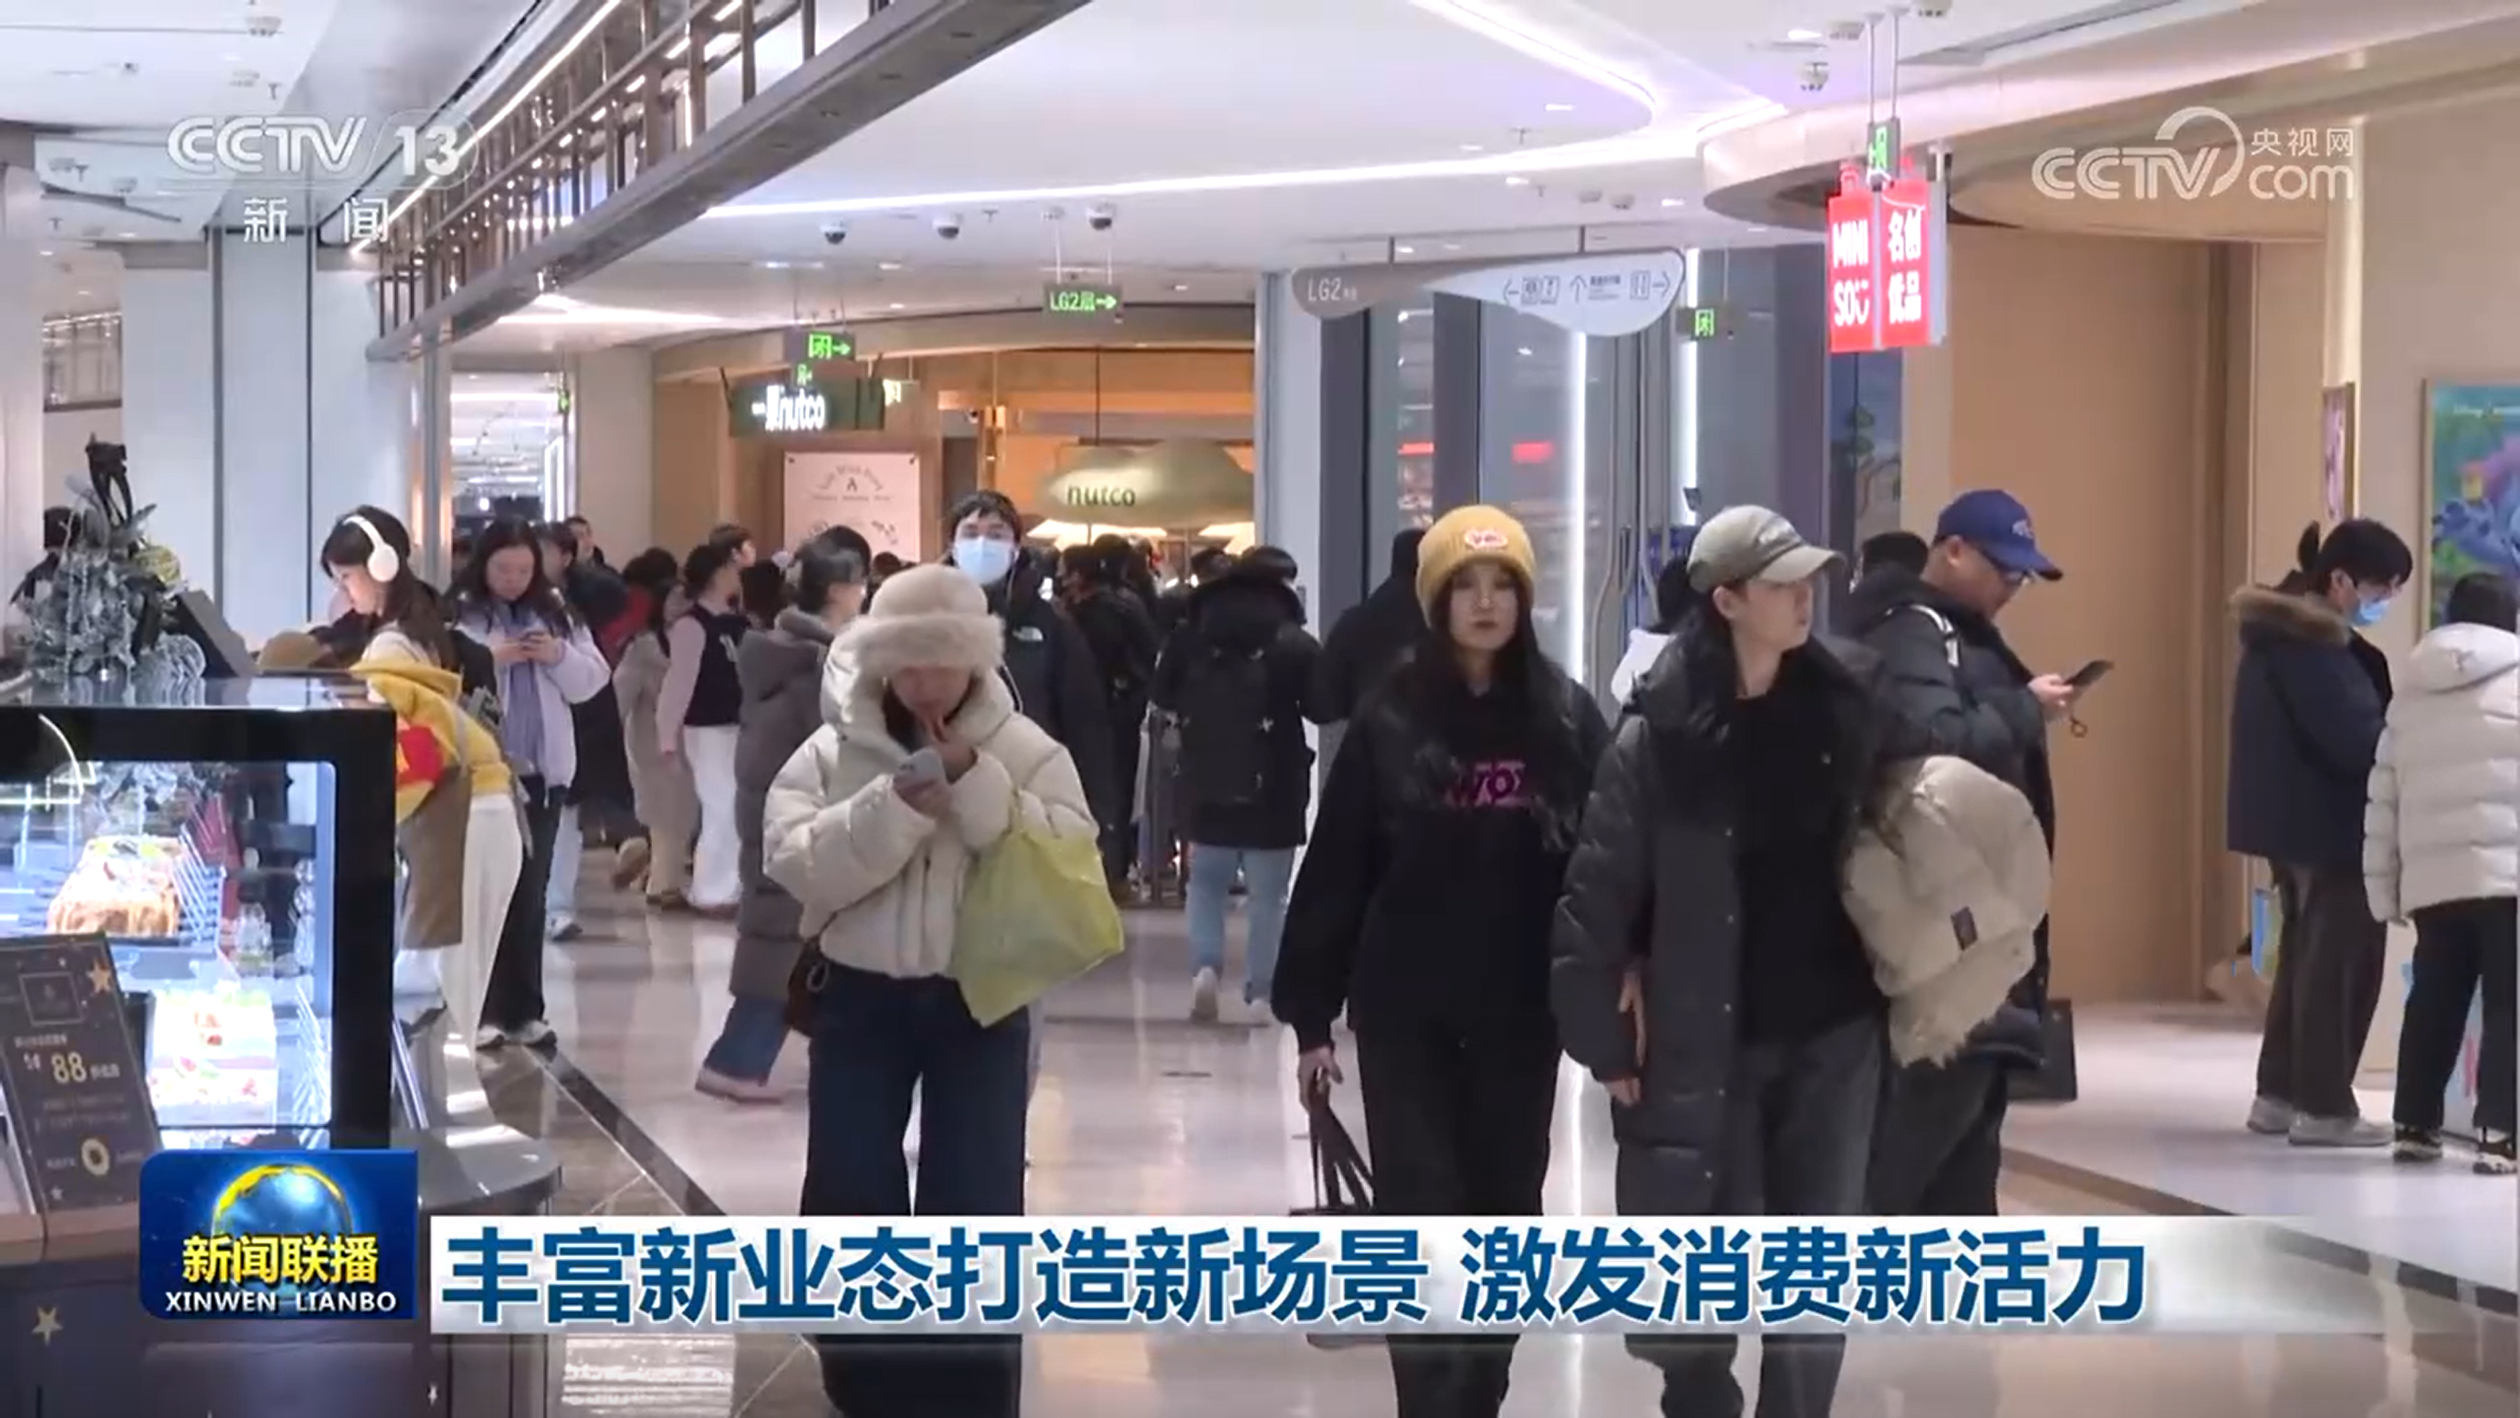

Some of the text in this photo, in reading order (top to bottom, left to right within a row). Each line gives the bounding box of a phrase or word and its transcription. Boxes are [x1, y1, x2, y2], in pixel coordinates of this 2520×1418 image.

[1833, 220, 1869, 268] MINI
[1308, 277, 1342, 301] LG2
[1067, 484, 1136, 507] nutco
[51, 1052, 87, 1085] 88
